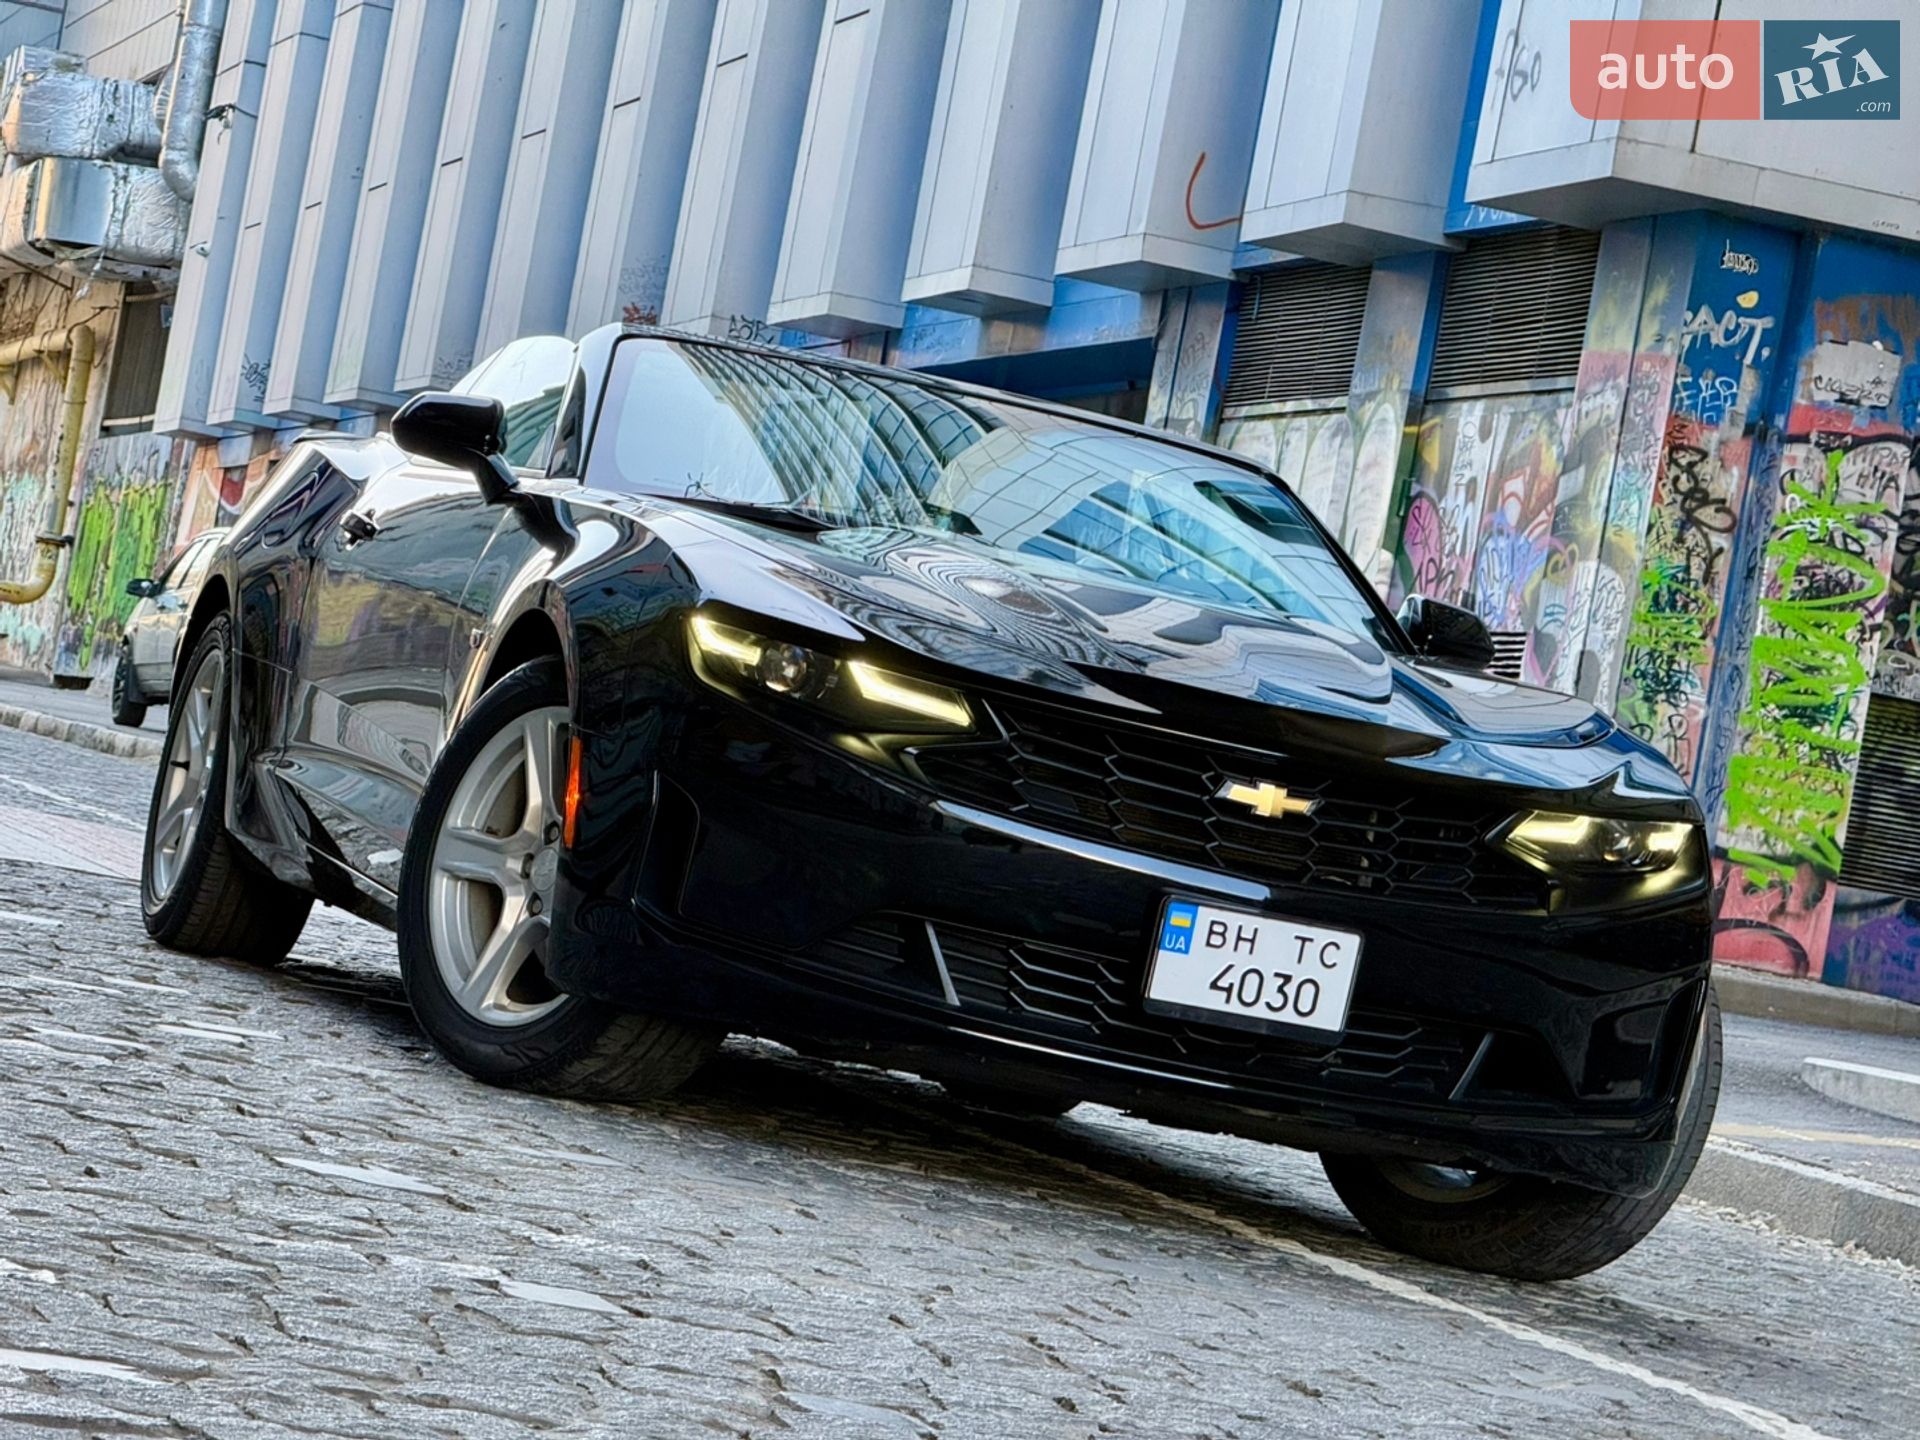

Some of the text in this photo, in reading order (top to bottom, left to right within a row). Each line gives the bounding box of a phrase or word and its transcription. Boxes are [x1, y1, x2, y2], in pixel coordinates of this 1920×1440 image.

[1165, 933, 1187, 951] UA
[1205, 919, 1341, 969] BH TC
[1209, 964, 1320, 1018] 4030
